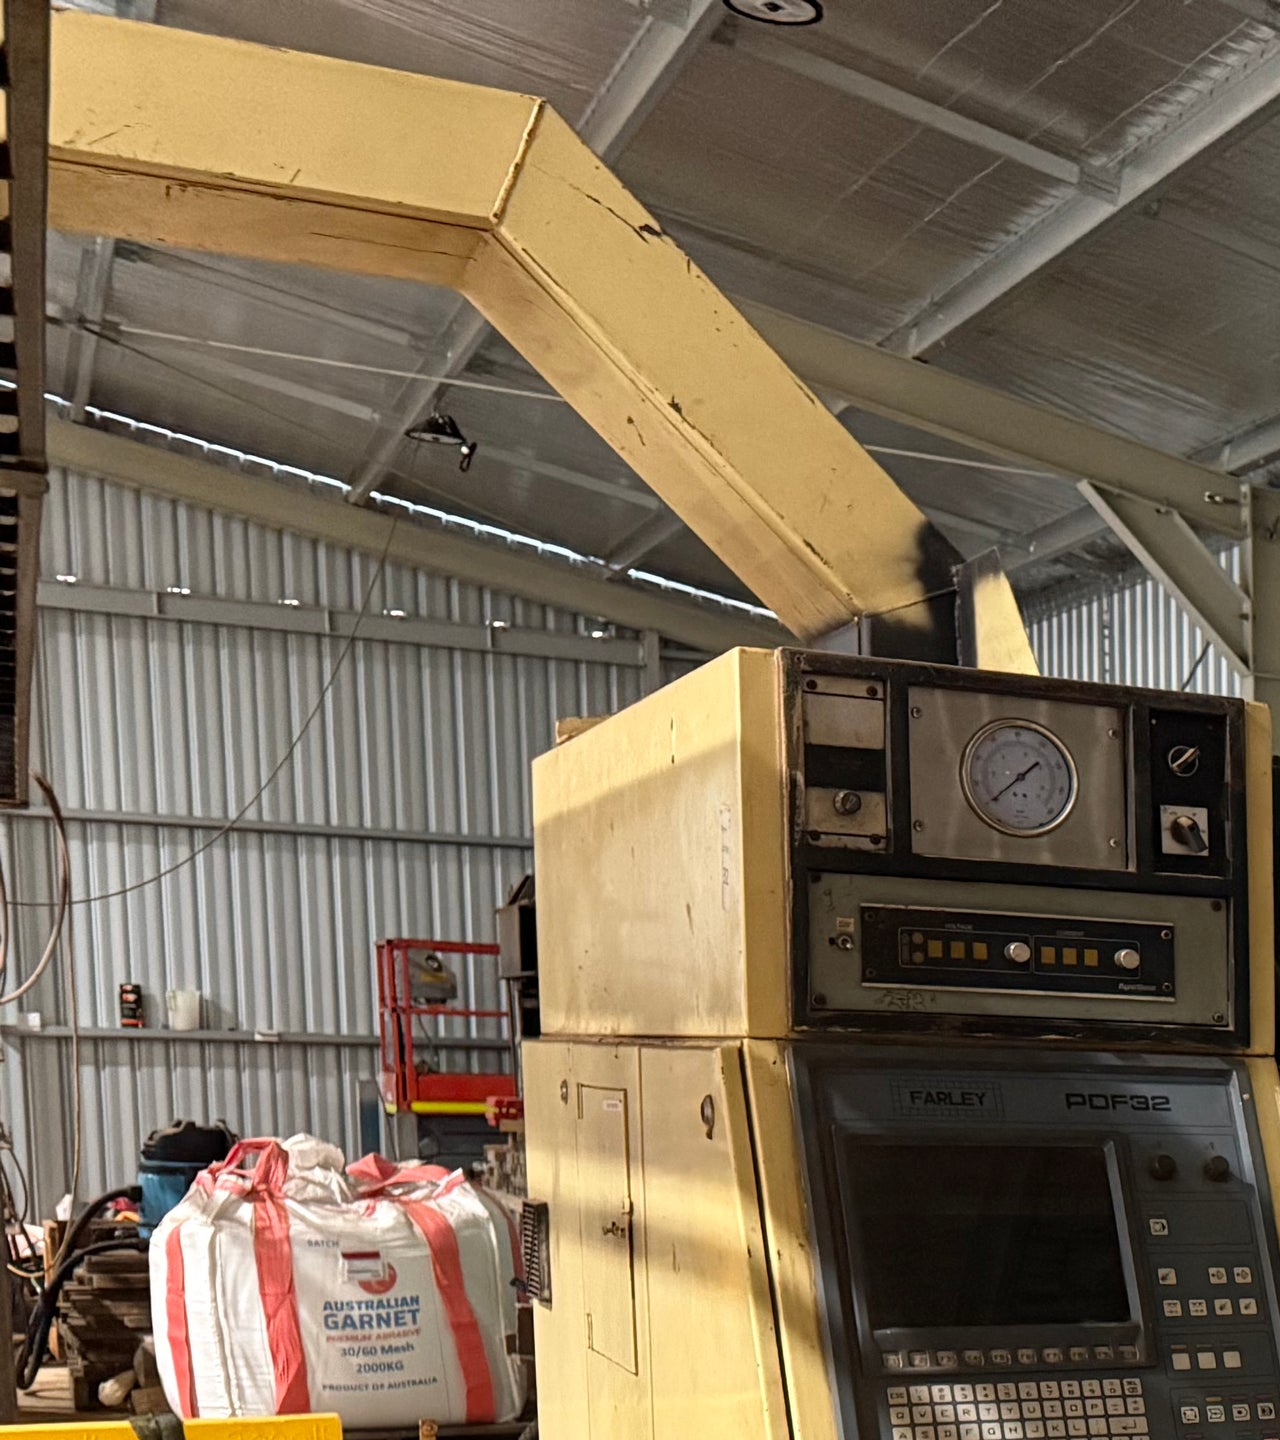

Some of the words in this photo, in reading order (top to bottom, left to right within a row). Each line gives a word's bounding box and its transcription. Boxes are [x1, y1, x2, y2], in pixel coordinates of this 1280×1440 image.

[909, 1090, 987, 1107] FARLEY
[1065, 1093, 1172, 1112] PDF32
[323, 1295, 420, 1312] AUSTRALIAN
[323, 1309, 420, 1331] GARNET
[340, 1345, 377, 1358] 30/60
[381, 1342, 415, 1354] Mesh
[356, 1361, 404, 1374] 2000KG
[322, 1383, 369, 1392] PRODUCT
[387, 1376, 438, 1390] AUSTRALIA
